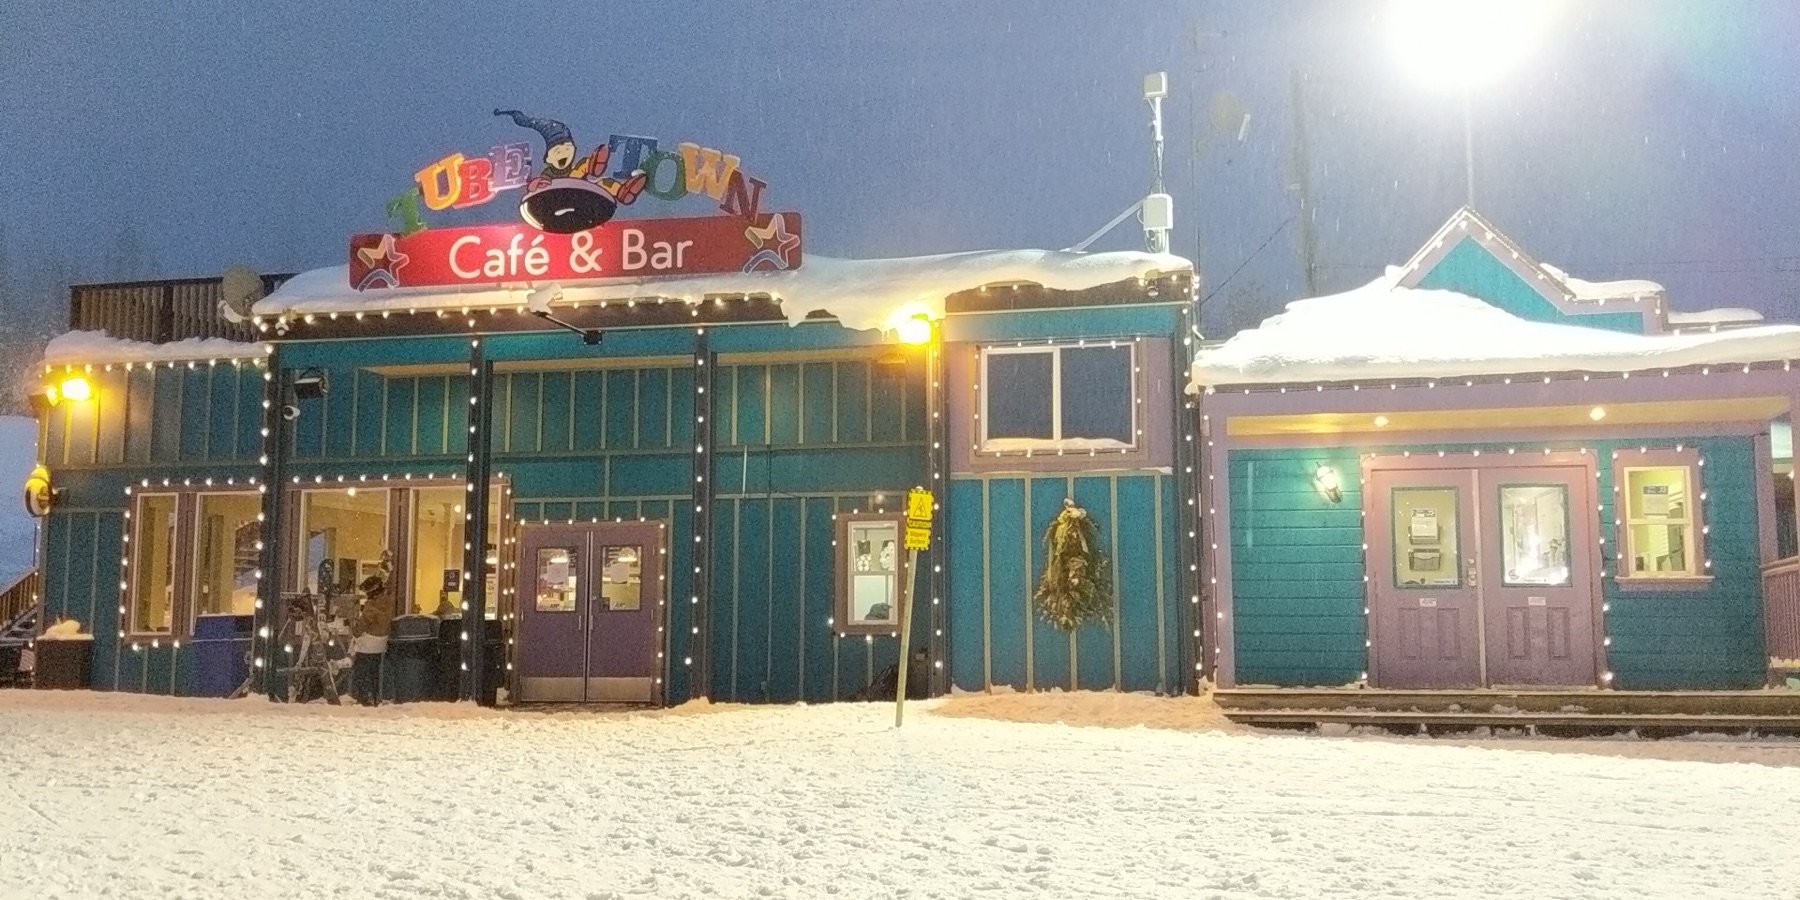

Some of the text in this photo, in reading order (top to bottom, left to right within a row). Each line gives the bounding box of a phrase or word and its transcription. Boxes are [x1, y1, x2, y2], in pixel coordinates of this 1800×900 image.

[386, 134, 767, 236] TUBE TOWN
[449, 229, 694, 279] Café & Bar
